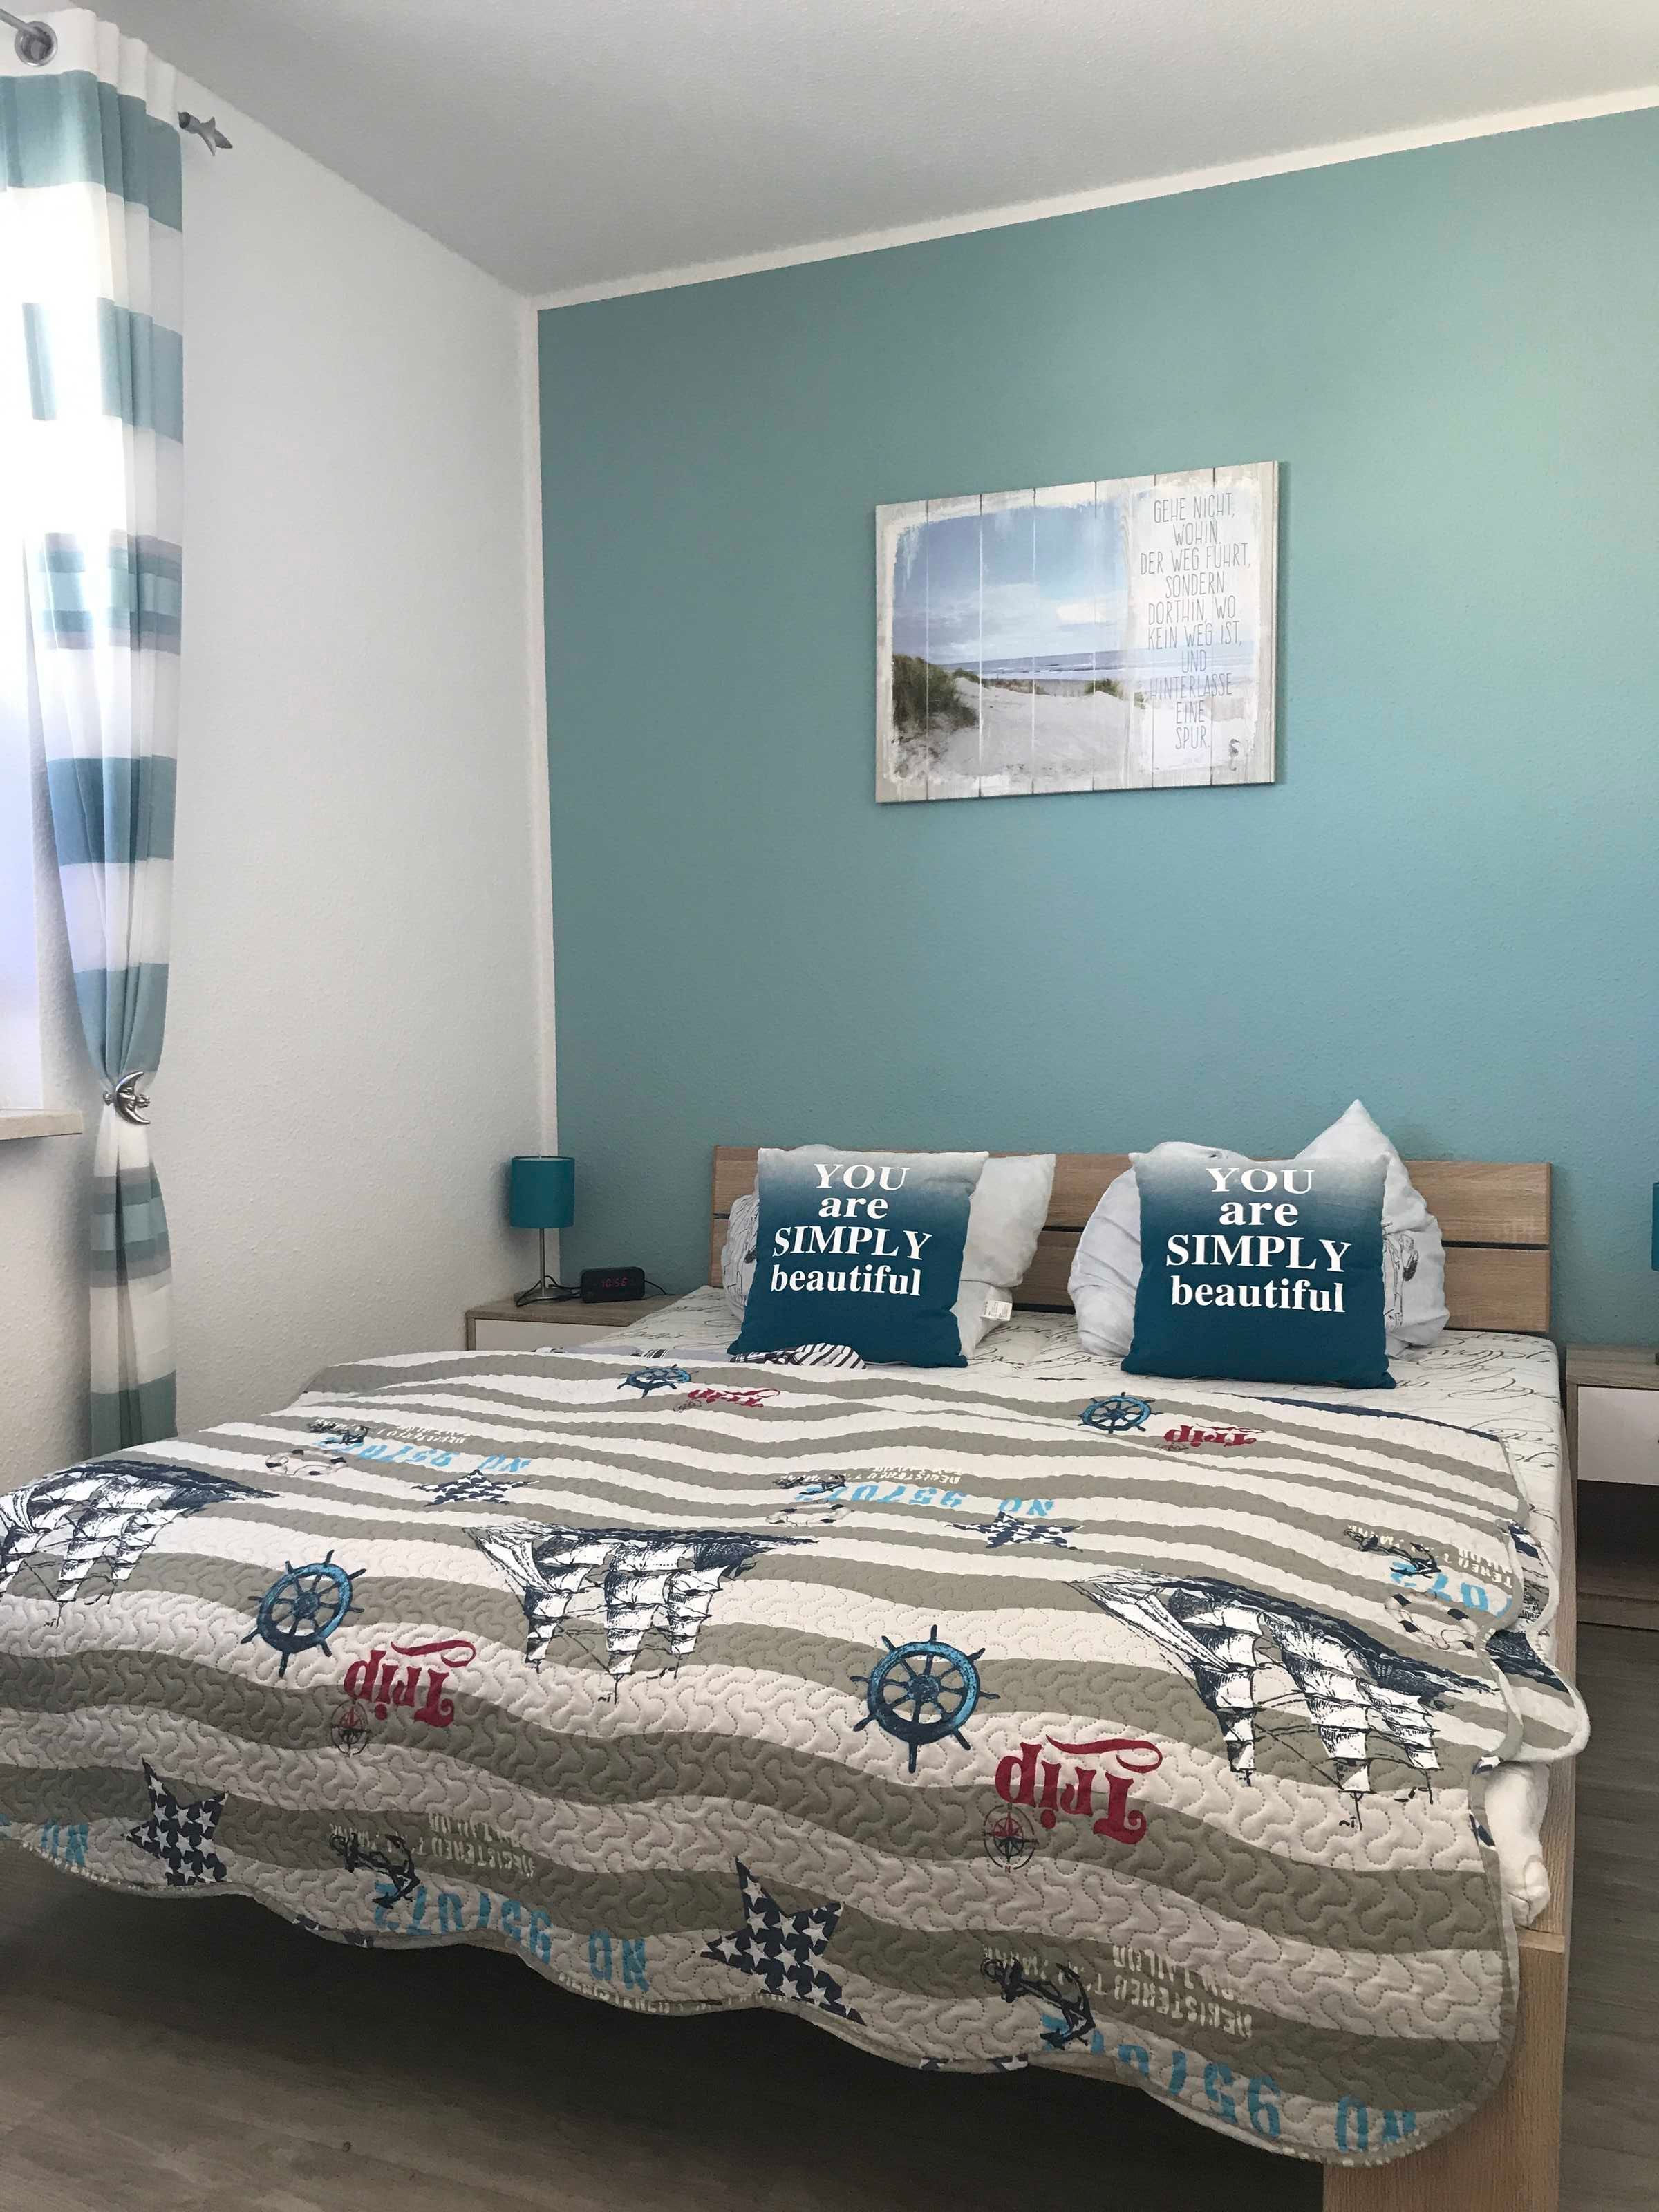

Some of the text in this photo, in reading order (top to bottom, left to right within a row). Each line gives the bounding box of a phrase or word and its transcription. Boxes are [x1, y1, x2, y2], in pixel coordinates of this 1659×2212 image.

[1153, 491, 1236, 524] GEHE NICHT,
[1140, 551, 1164, 575] DER
[1171, 547, 1200, 572] WEG
[1165, 570, 1226, 599] SONDERN
[1148, 594, 1237, 626] DORTHIN, WO
[1147, 619, 1243, 650] KEIN WEG IST,
[1181, 648, 1208, 673] UND
[1150, 672, 1234, 700] HINTERLASSE
[1175, 700, 1206, 724] EINE
[1174, 725, 1211, 750] SPUR.
[814, 1163, 910, 1192] YOU
[1206, 1168, 1315, 1194] YOU
[818, 1197, 889, 1219] are
[1219, 1201, 1298, 1227] are
[772, 1226, 933, 1261] SIMPLY
[1166, 1234, 1352, 1273] SIMPLY
[770, 1264, 922, 1297] beautiful
[1170, 1275, 1347, 1313] beautiful
[1163, 1425, 1257, 1447] Trip
[343, 1649, 456, 1728] Trip
[994, 1742, 1147, 1845] Trip
